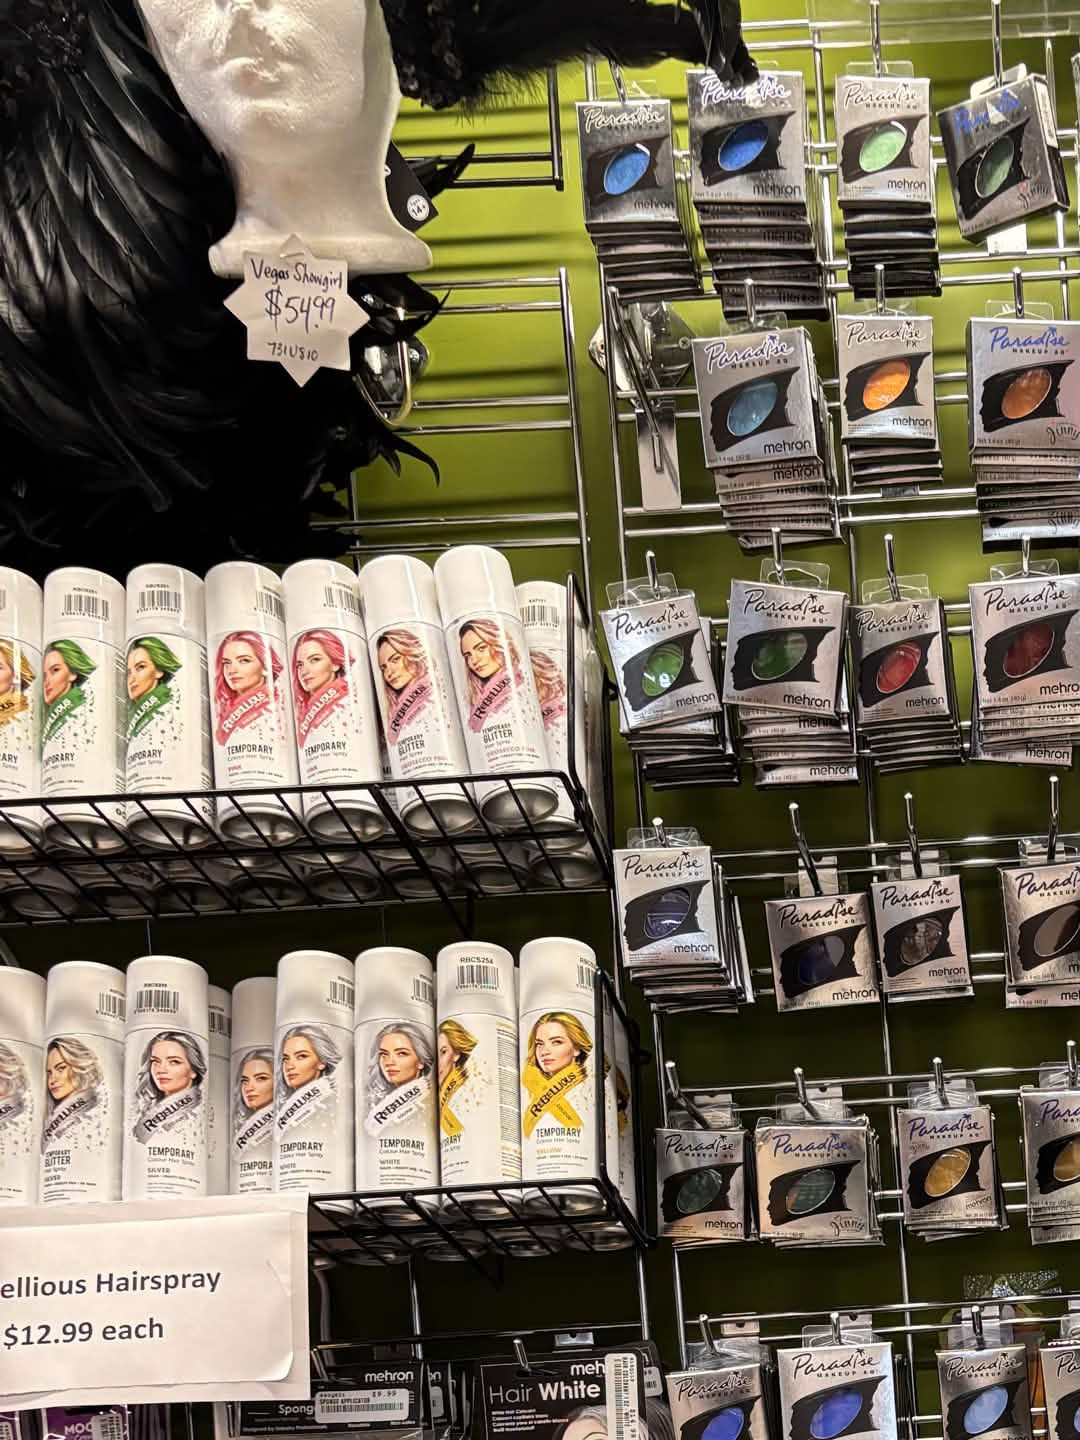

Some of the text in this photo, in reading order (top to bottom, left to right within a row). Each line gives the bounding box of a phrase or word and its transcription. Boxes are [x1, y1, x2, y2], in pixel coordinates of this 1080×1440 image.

[585, 104, 665, 132] Paradise
[887, 177, 927, 191] mehron
[250, 258, 343, 292] Vegas Showgirl
[847, 322, 922, 346] Paradise
[610, 604, 689, 639] Paradise
[783, 693, 831, 709] mehron
[483, 729, 513, 744] GLITTER
[227, 744, 274, 755] TEMPORARY
[673, 942, 715, 954] mehron
[536, 1127, 582, 1138] TEMPORARY
[379, 1138, 425, 1151] TEMPORARY
[148, 1146, 195, 1161] TEMPORARY
[96, 1271, 221, 1293] Hairspray
[4, 1317, 165, 1349] $12.99 each
[365, 1369, 414, 1383] mehron
[489, 1379, 601, 1405] Hair White
[279, 1404, 315, 1417] Spong
